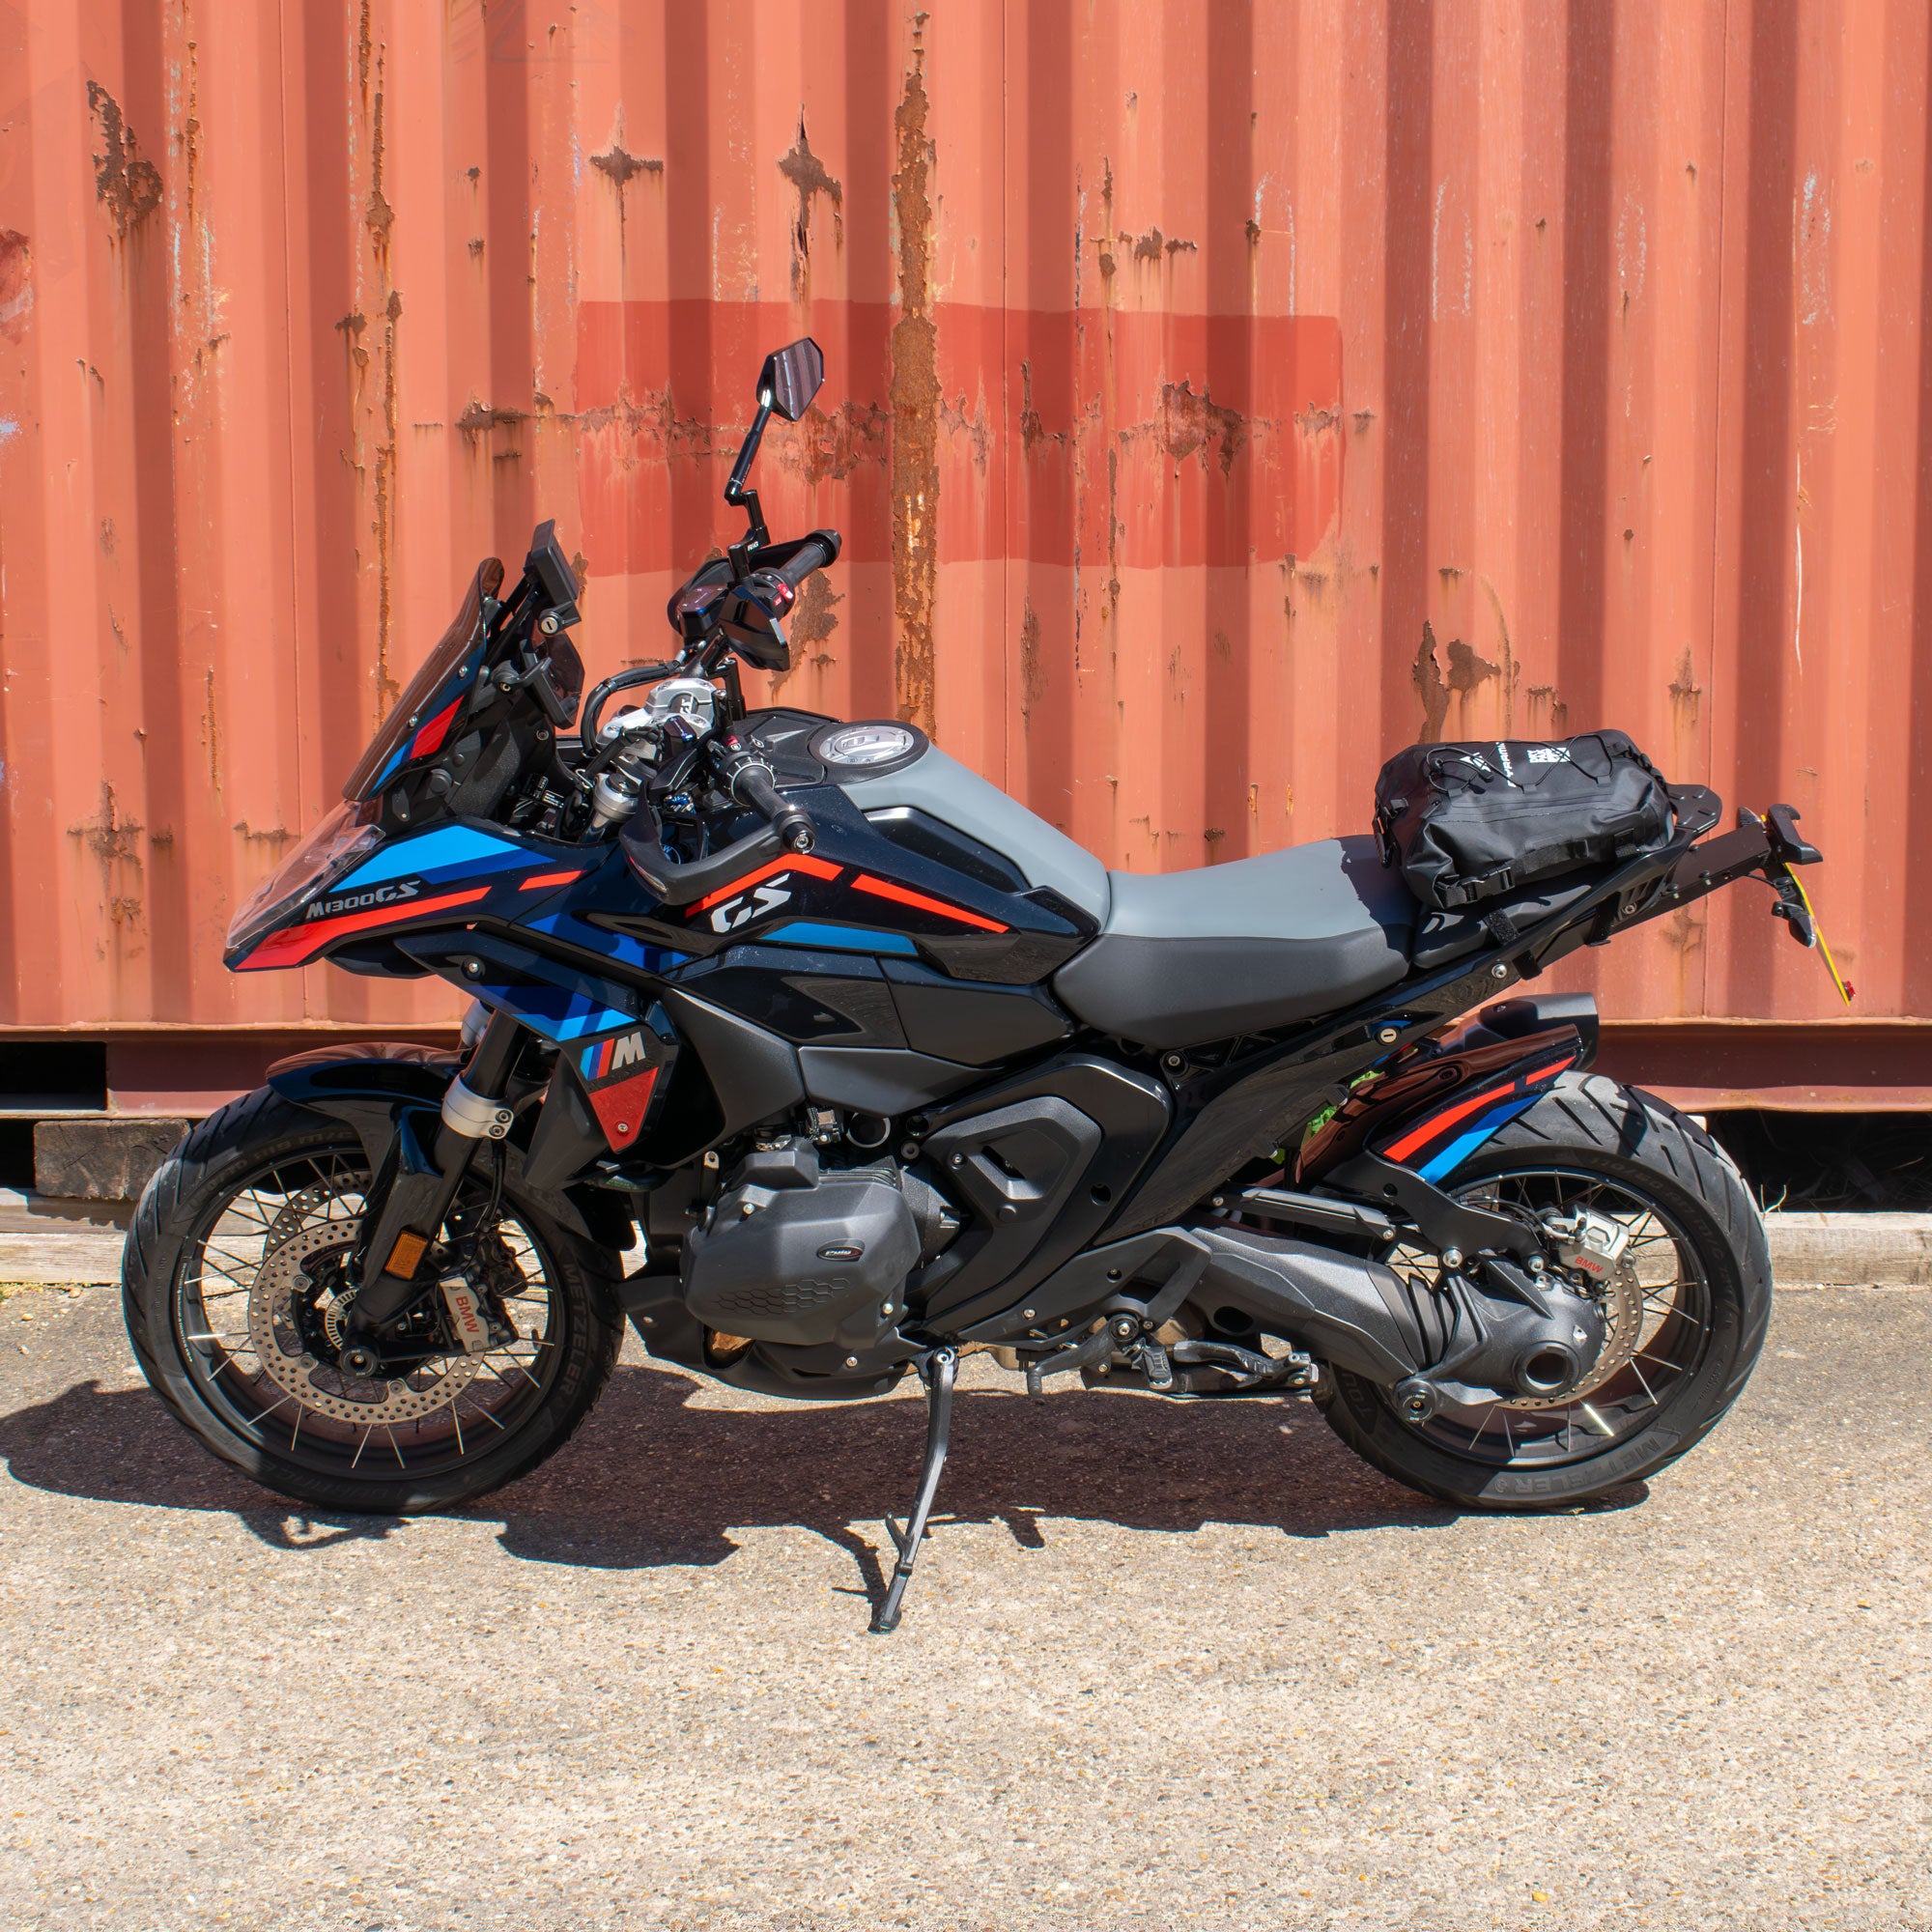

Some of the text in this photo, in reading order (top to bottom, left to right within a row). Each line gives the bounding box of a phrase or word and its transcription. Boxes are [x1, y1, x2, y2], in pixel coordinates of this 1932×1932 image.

[711, 872, 792, 933] GS
[611, 1031, 646, 1070] M
[1575, 1256, 1605, 1273] BMW
[455, 1296, 480, 1332] BMW
[559, 1263, 588, 1397] METZELER
